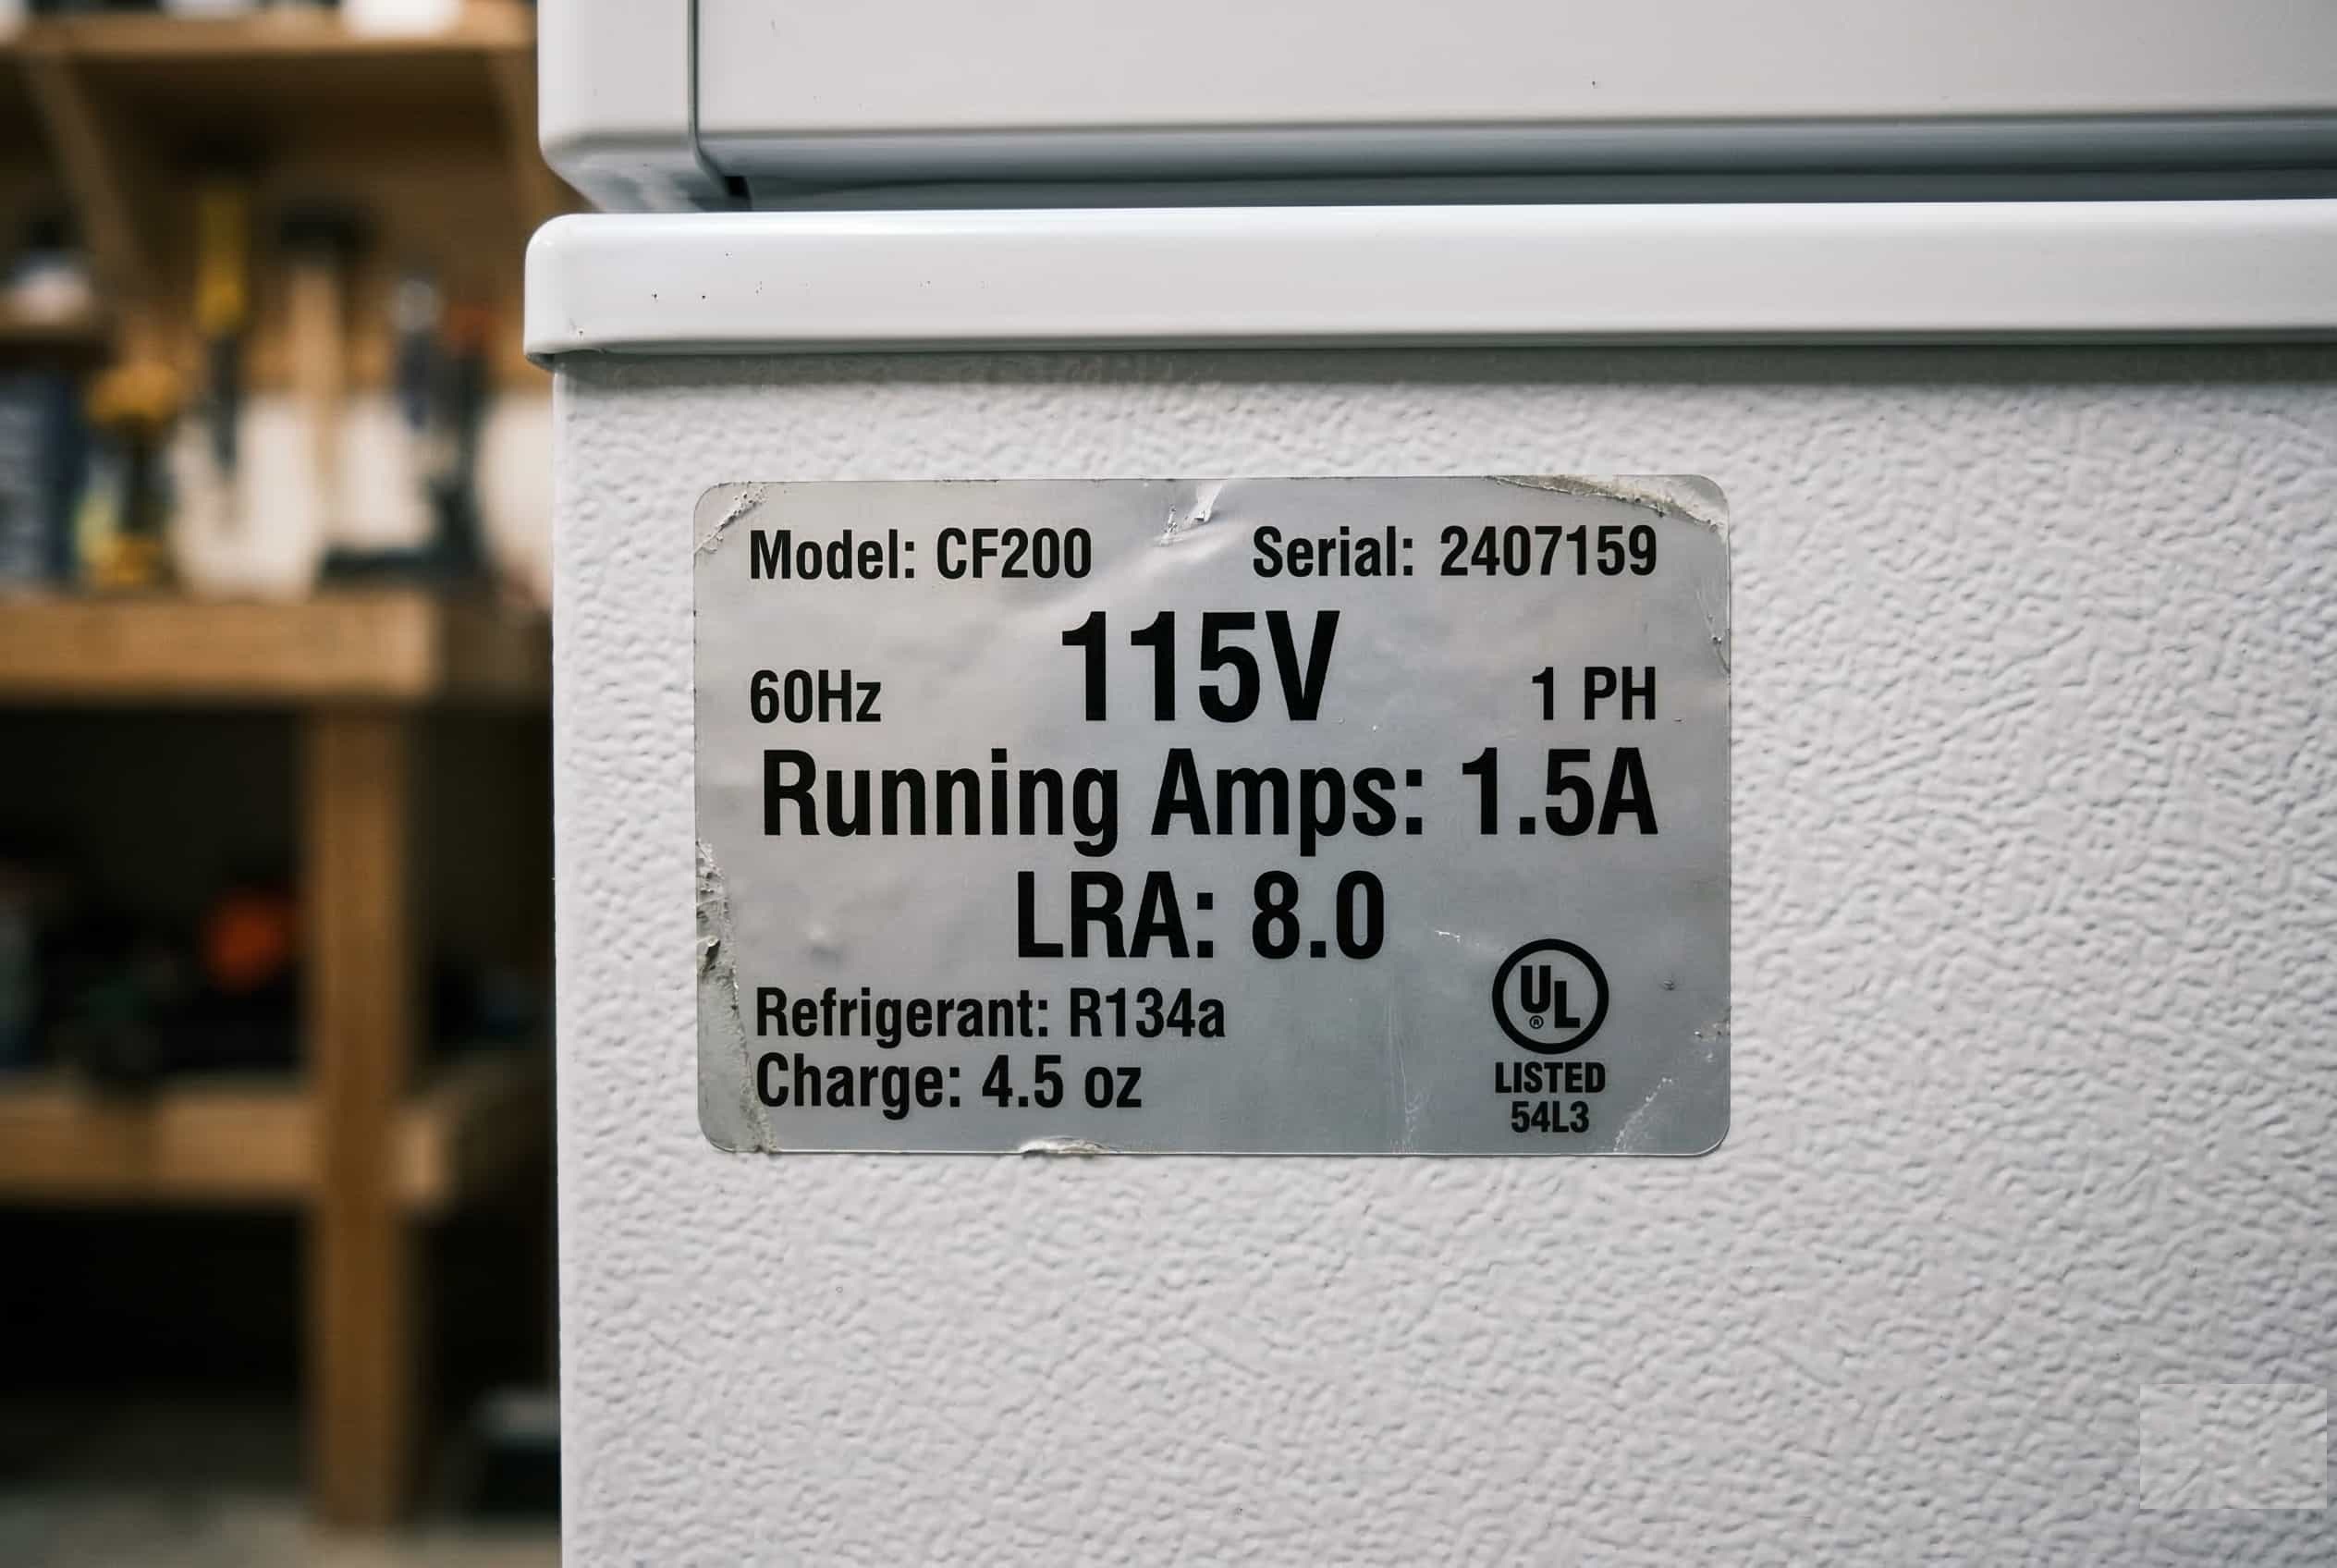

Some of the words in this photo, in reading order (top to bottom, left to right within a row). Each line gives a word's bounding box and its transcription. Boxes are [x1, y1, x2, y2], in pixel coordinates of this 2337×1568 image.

[750, 530, 916, 580] Model:
[936, 527, 1092, 580] CF200
[1253, 525, 1413, 578] Serial:
[1440, 524, 1657, 577] 2407159
[1061, 610, 1340, 723] 115V
[1532, 667, 1554, 721] 1
[1584, 666, 1656, 721] PH
[750, 669, 881, 724] 60Hz
[764, 748, 1119, 858] Running
[1150, 747, 1423, 858] Amps:
[1462, 746, 1658, 837] 1.5A
[1017, 870, 1214, 959] LRA:
[1252, 870, 1386, 960] 8.0
[756, 986, 1048, 1049] Refrigerant:
[1070, 986, 1226, 1038] R134a
[756, 1051, 960, 1121] Charge:
[982, 1054, 1064, 1109] 4.5
[1084, 1066, 1143, 1109] oz
[1494, 1060, 1606, 1094] LISTED
[1511, 1100, 1590, 1133] 54L3
